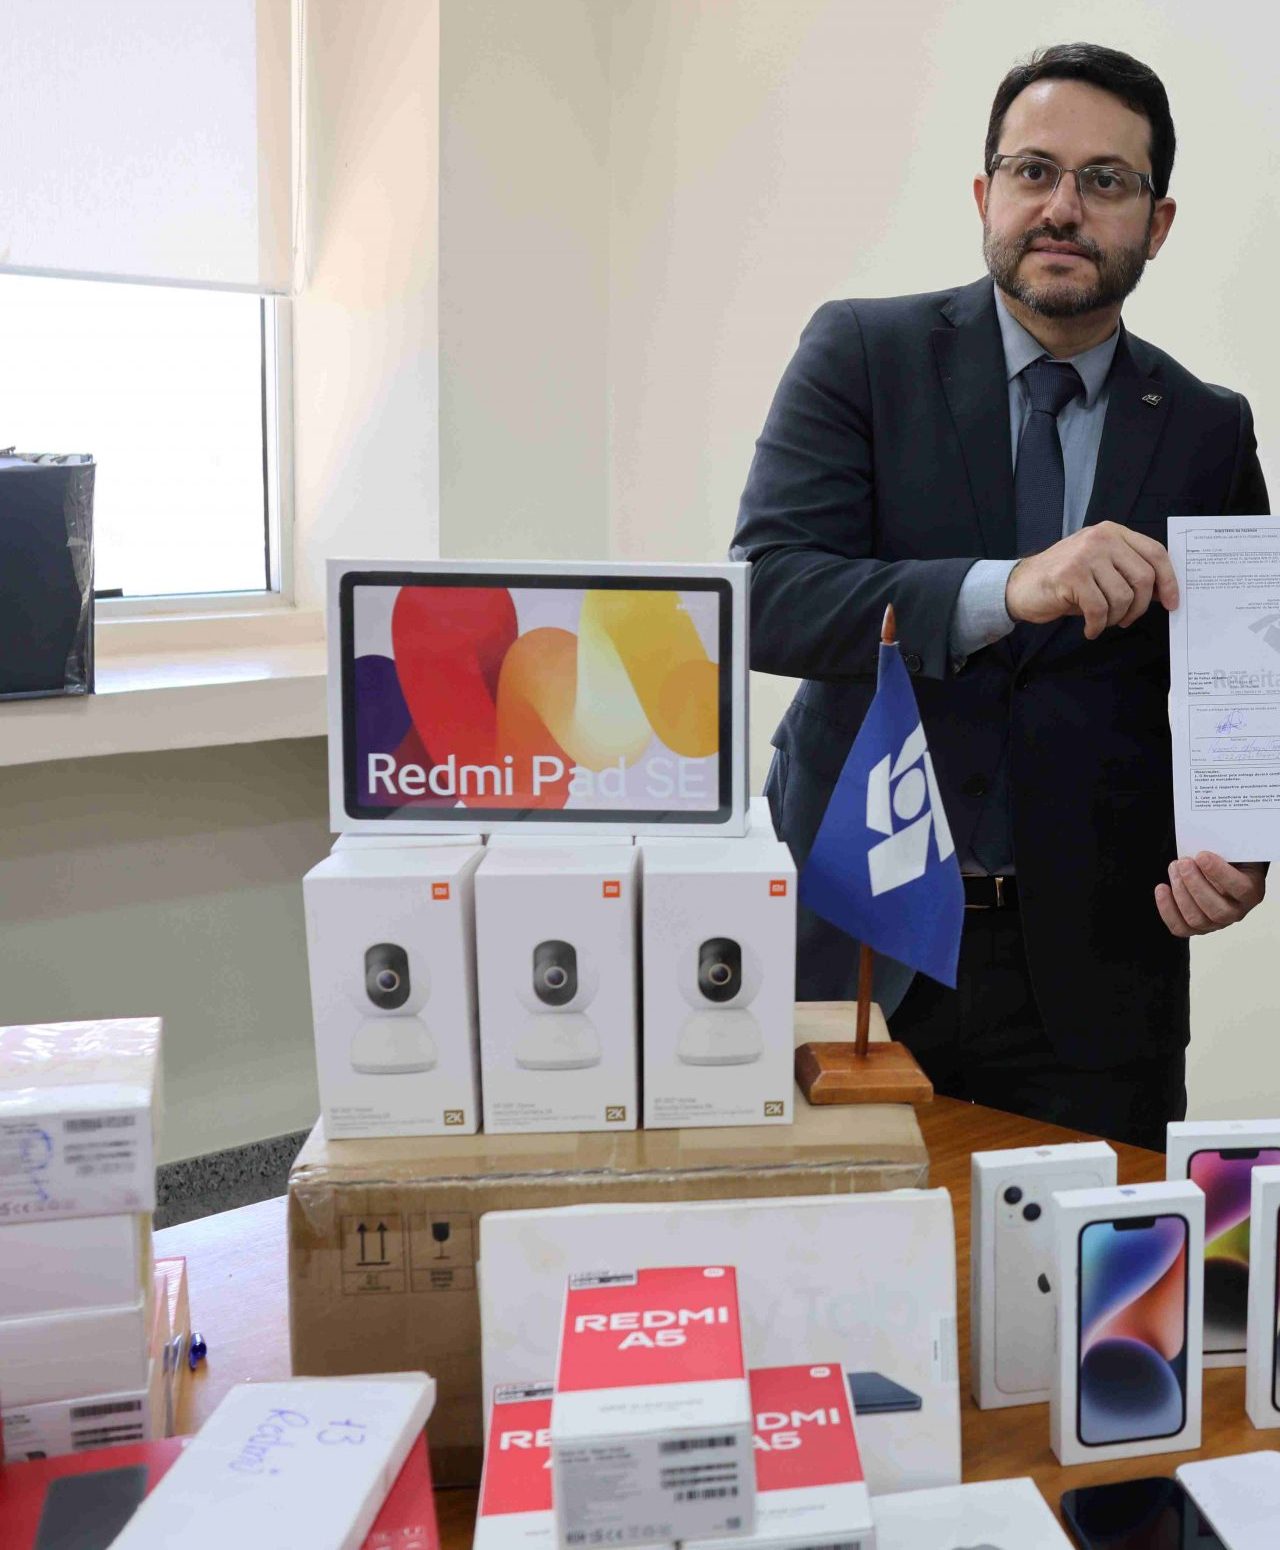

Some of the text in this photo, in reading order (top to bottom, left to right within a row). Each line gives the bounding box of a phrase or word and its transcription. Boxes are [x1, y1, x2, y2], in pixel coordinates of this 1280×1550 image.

[367, 752, 707, 798] Redmi Pad SE
[445, 1111, 463, 1124] 2K
[607, 1107, 624, 1120] 2K
[766, 1103, 782, 1115] 2K
[574, 1306, 729, 1334] REDMI
[618, 1329, 687, 1351] A5
[756, 1407, 840, 1431] DMI
